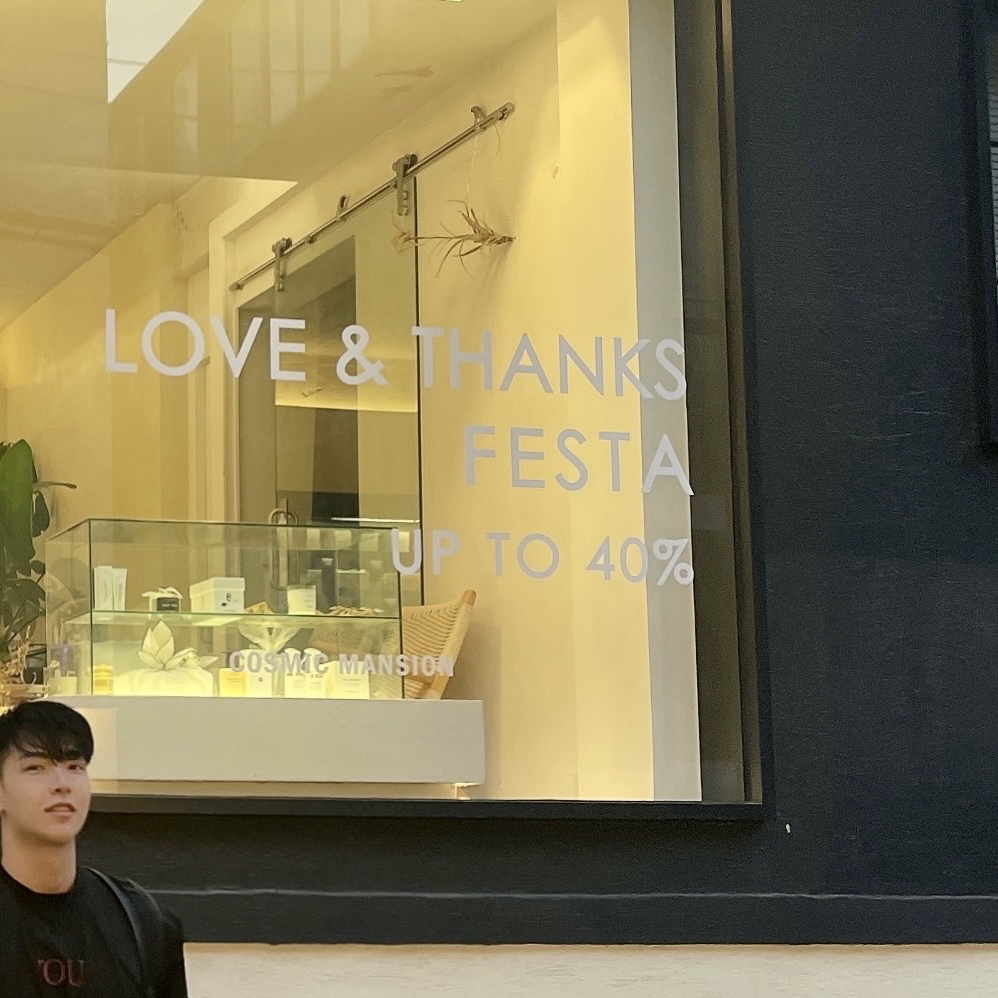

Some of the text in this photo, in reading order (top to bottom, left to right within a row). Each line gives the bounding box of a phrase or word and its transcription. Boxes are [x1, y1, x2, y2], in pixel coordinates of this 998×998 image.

[105, 308, 688, 400] LOVE & THANKS
[463, 425, 694, 496] FESTA
[391, 528, 694, 586] UP TO 40%
[229, 650, 454, 677] COSMIC MANSION
